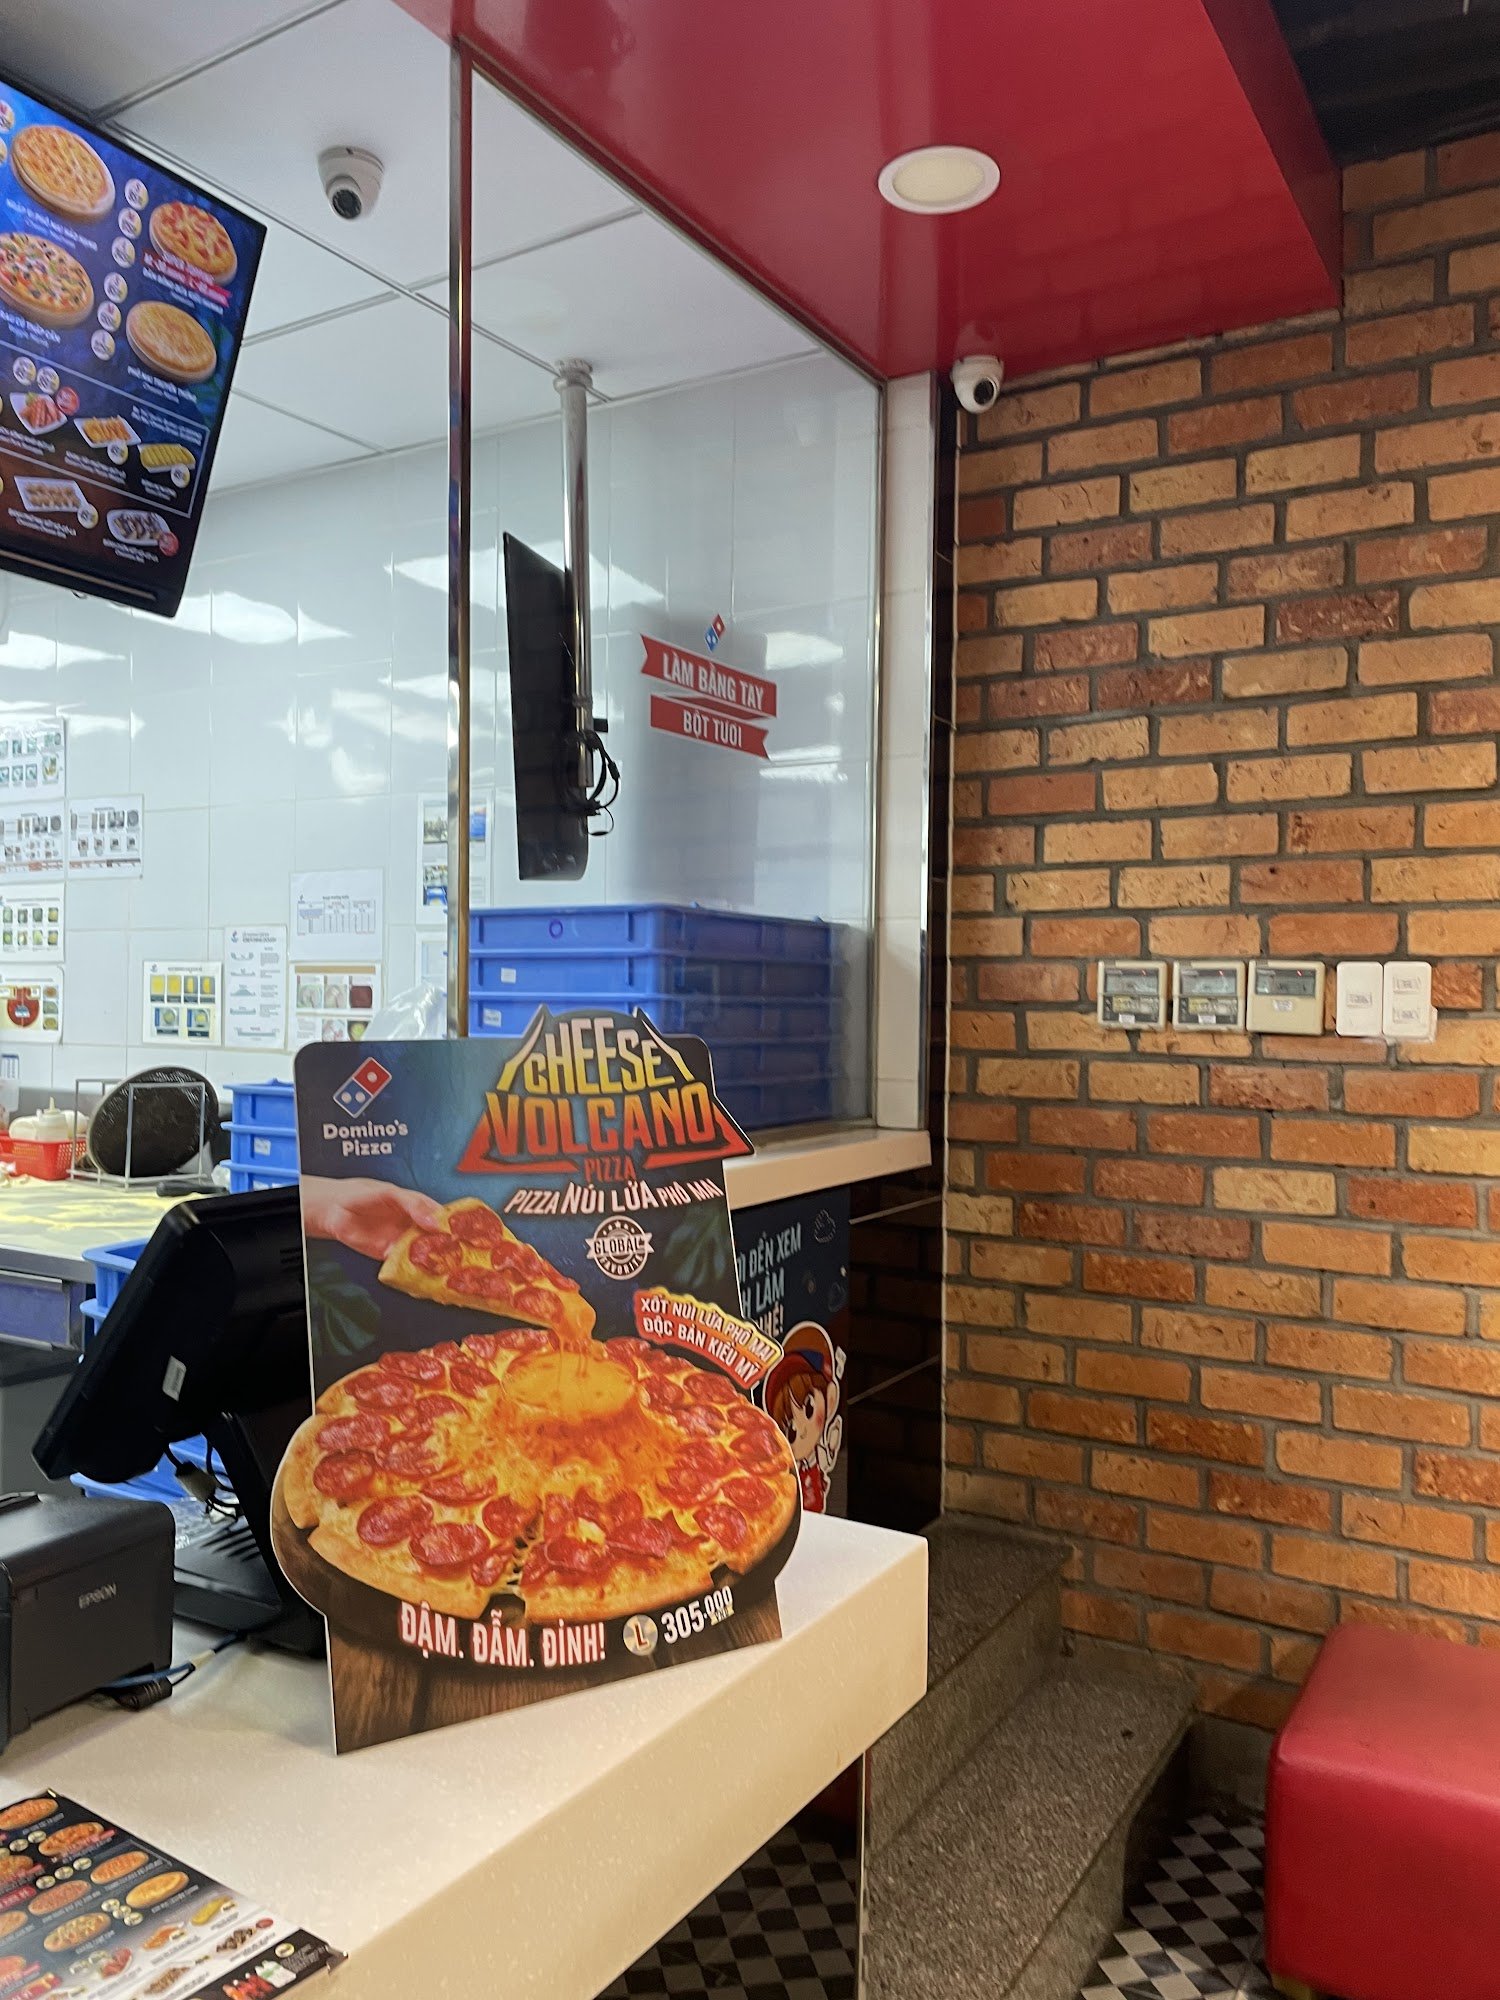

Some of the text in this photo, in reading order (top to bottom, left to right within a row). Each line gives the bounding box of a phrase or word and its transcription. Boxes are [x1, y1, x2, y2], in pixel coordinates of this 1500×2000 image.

[663, 652, 694, 688] LÀM
[740, 680, 764, 711] TAY
[683, 710, 710, 739] BỘT
[523, 1017, 676, 1094] CHEESE
[323, 1119, 408, 1140] Domino's
[486, 1081, 716, 1155] VOLCANO
[342, 1139, 392, 1156] Pizza
[584, 1156, 637, 1182] PIZZA
[504, 1178, 724, 1215] PIZZA NÚI LỬA PHÔ MAI
[594, 1237, 640, 1254] GLOBAL
[599, 1253, 644, 1275] FAVORITE
[749, 1231, 773, 1278] ĐẾN
[776, 1221, 801, 1262] XEM
[756, 1267, 785, 1313] LÀM
[643, 1315, 673, 1338] ĐỘC
[678, 1323, 707, 1349] BẢN
[672, 1302, 696, 1321] NÚI
[750, 1337, 776, 1363] MAI
[661, 1585, 734, 1644] 305.000
[401, 1600, 606, 1667] ĐẬM. ĐẪM. ĐỈNH!
[633, 1620, 650, 1651] L
